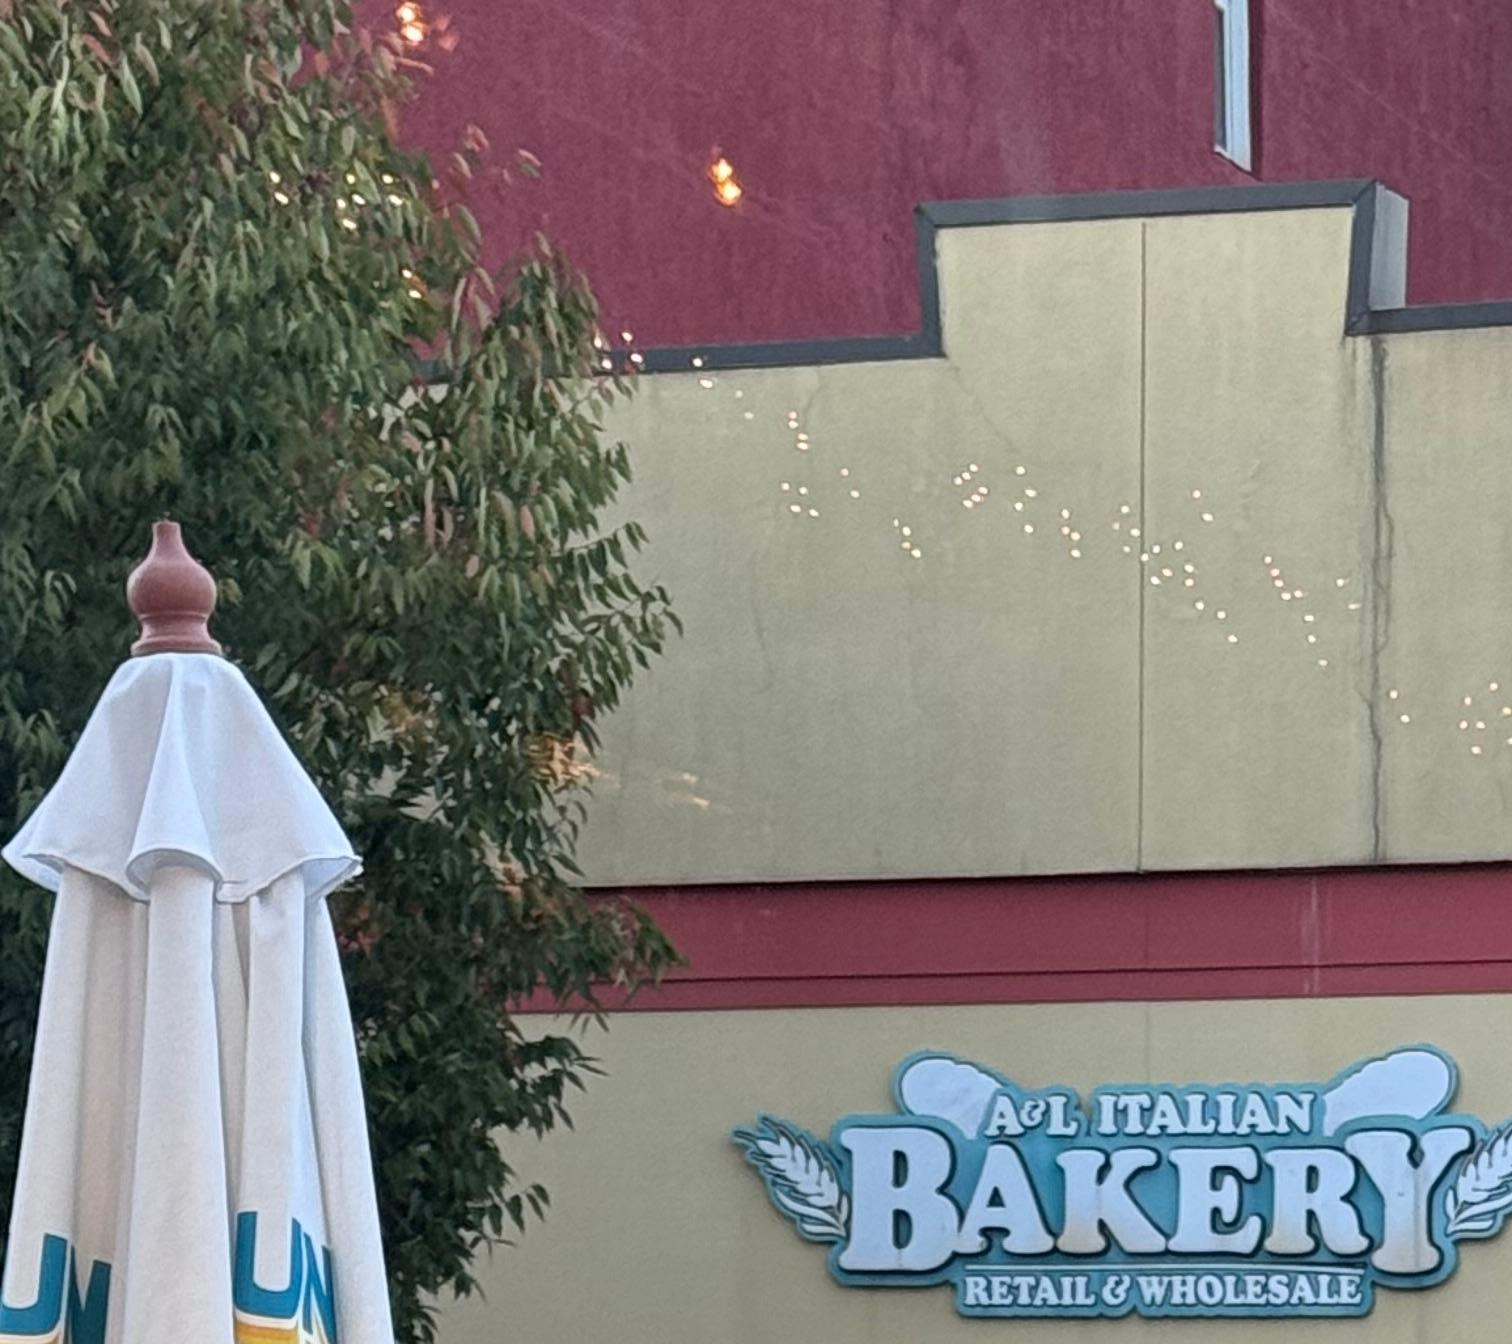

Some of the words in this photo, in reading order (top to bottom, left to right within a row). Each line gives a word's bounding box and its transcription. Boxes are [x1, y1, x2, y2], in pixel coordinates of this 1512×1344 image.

[985, 1094, 1079, 1136] A&L
[1097, 1093, 1314, 1135] ITALIAN
[837, 1125, 1473, 1274] BAKERY
[964, 1274, 1095, 1306] RETAIL
[1101, 1274, 1131, 1307] &
[1135, 1274, 1364, 1307] WHOLESALE
